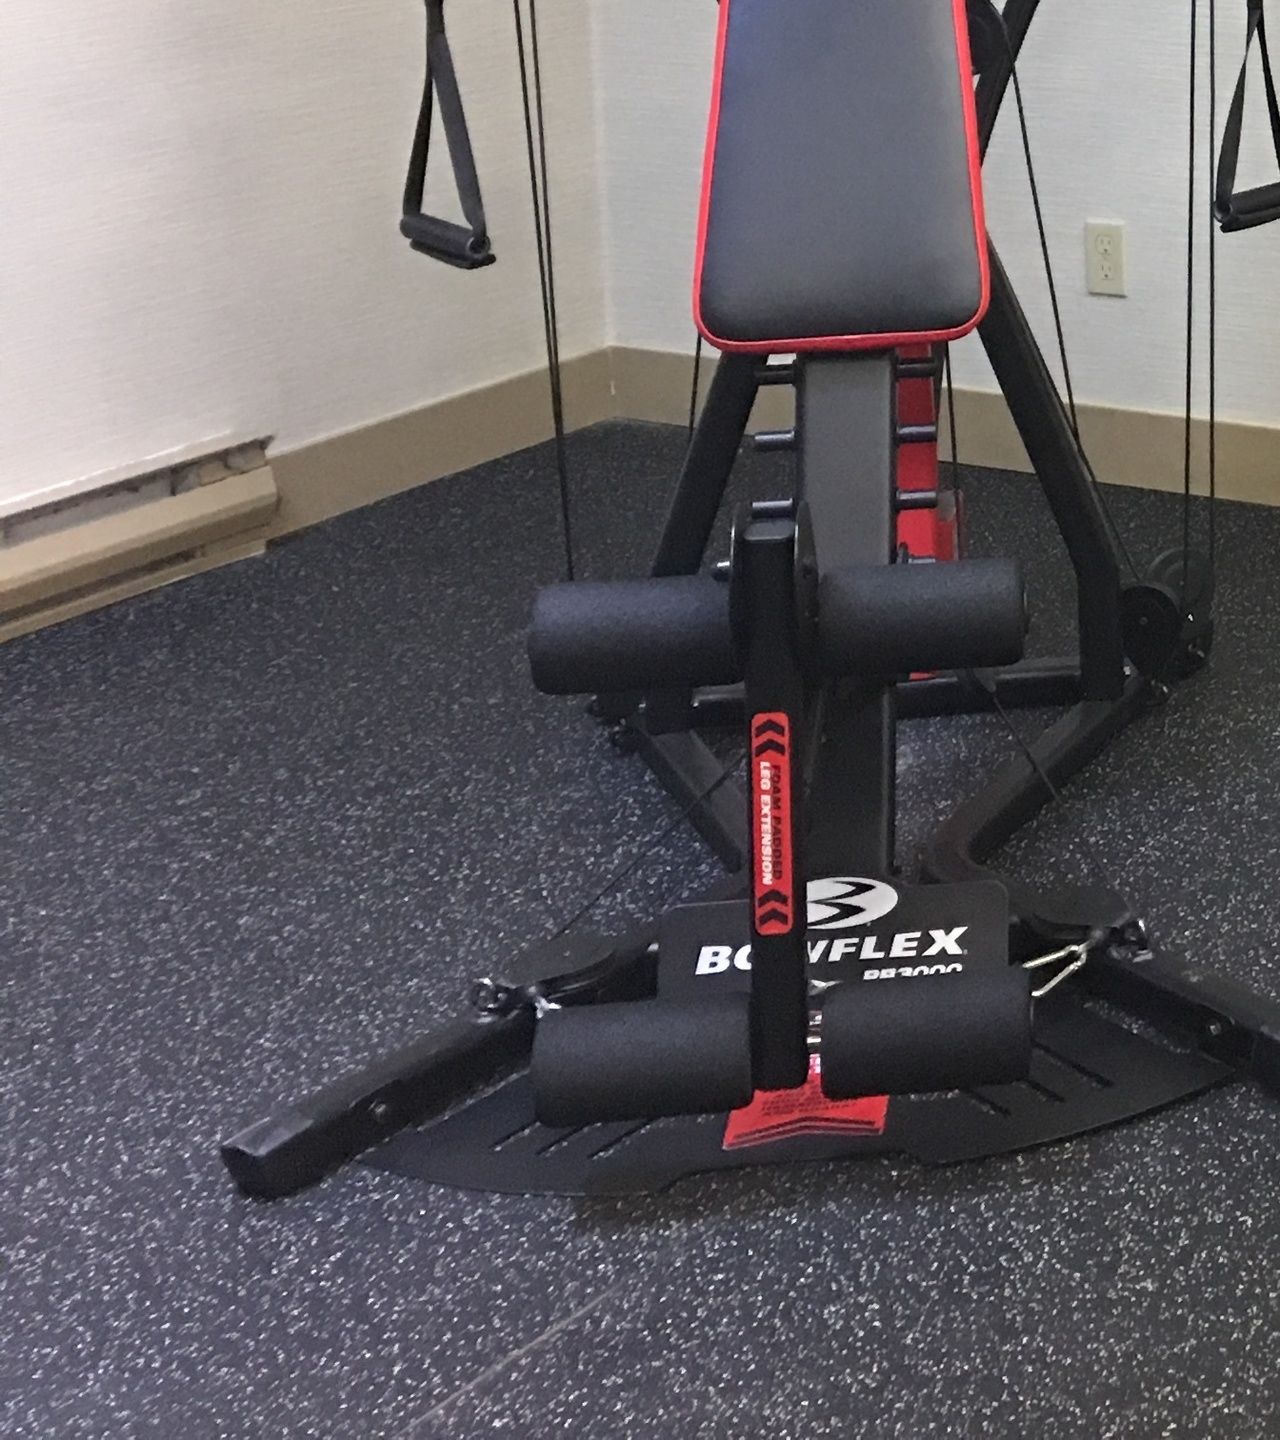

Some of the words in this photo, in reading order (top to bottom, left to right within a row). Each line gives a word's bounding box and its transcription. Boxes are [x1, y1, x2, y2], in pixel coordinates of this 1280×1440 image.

[760, 761, 771, 791] LEG
[772, 764, 782, 811] FOAM
[760, 794, 773, 885] EXTENSION
[772, 815, 783, 880] PADDED
